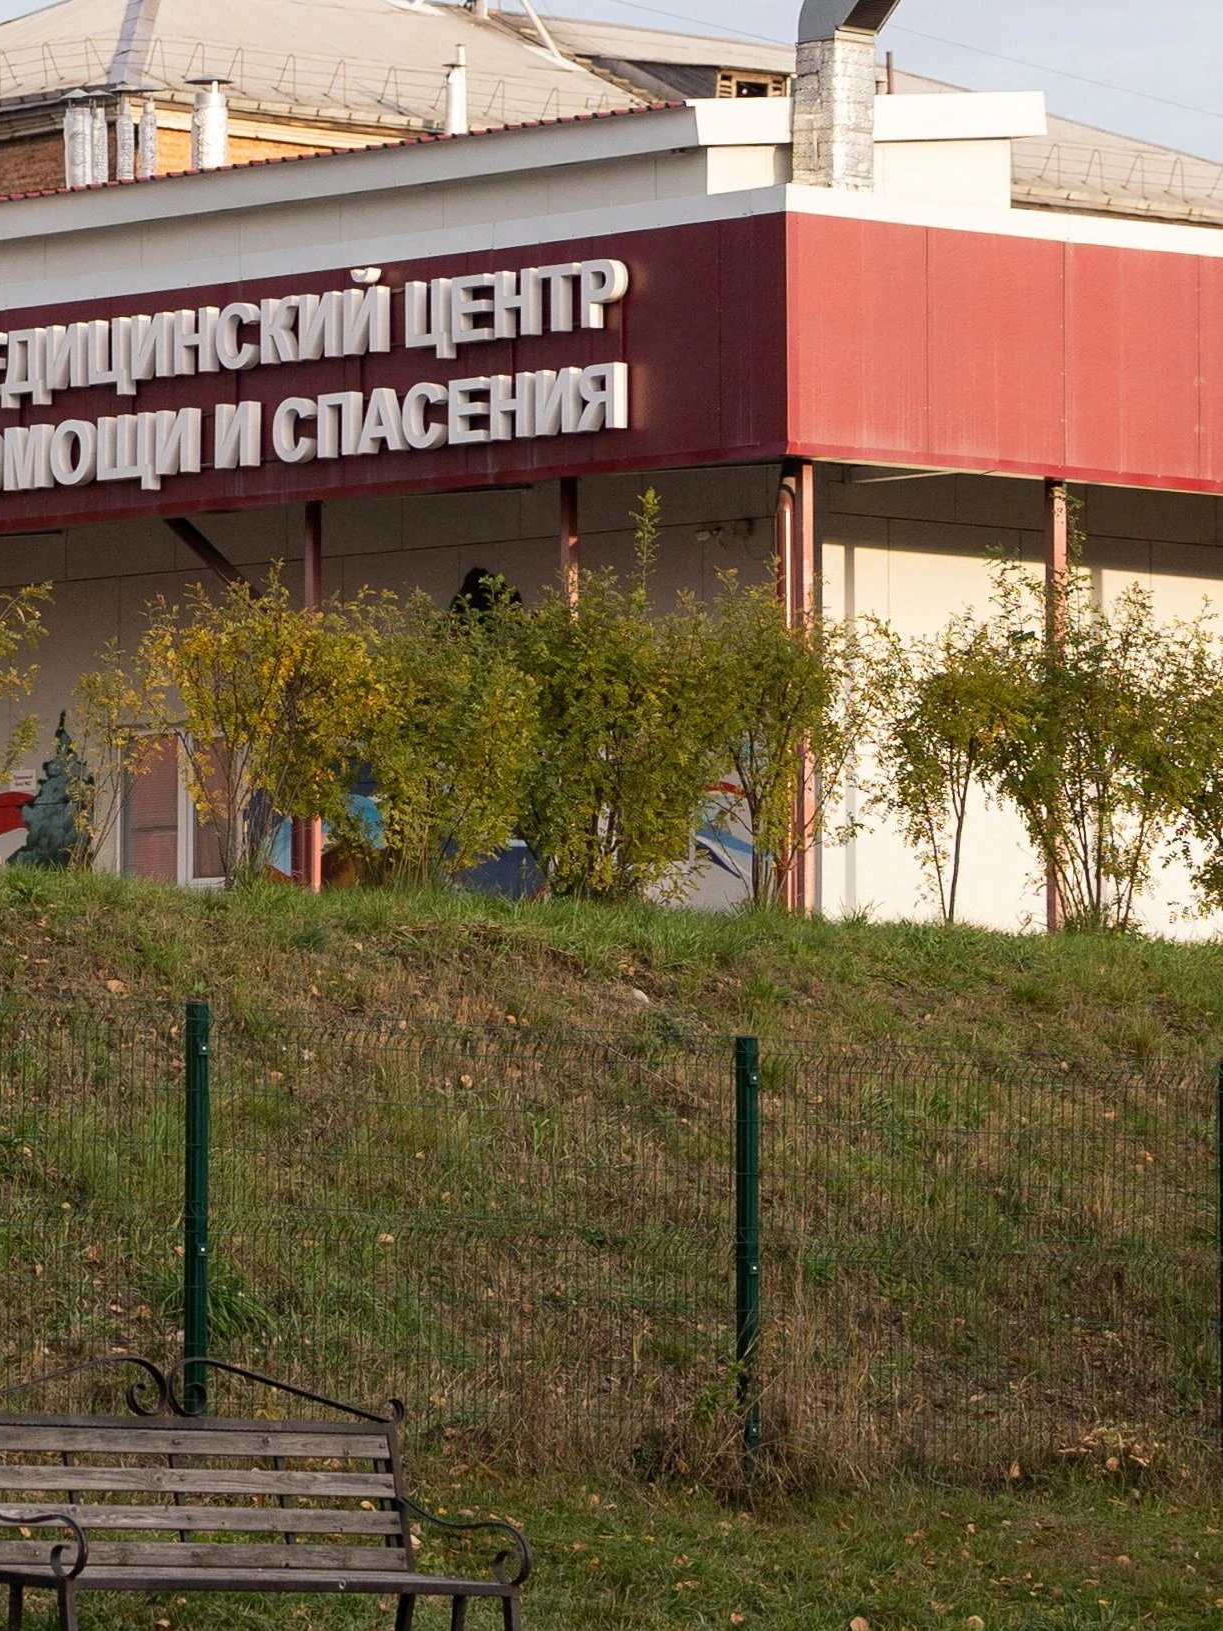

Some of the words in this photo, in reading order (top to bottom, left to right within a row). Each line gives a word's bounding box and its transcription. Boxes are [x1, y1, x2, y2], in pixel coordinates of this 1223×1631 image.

[404, 258, 629, 360] ЦЕНТР
[214, 401, 262, 470] И
[273, 361, 629, 464] СПАСЕНИЯ
